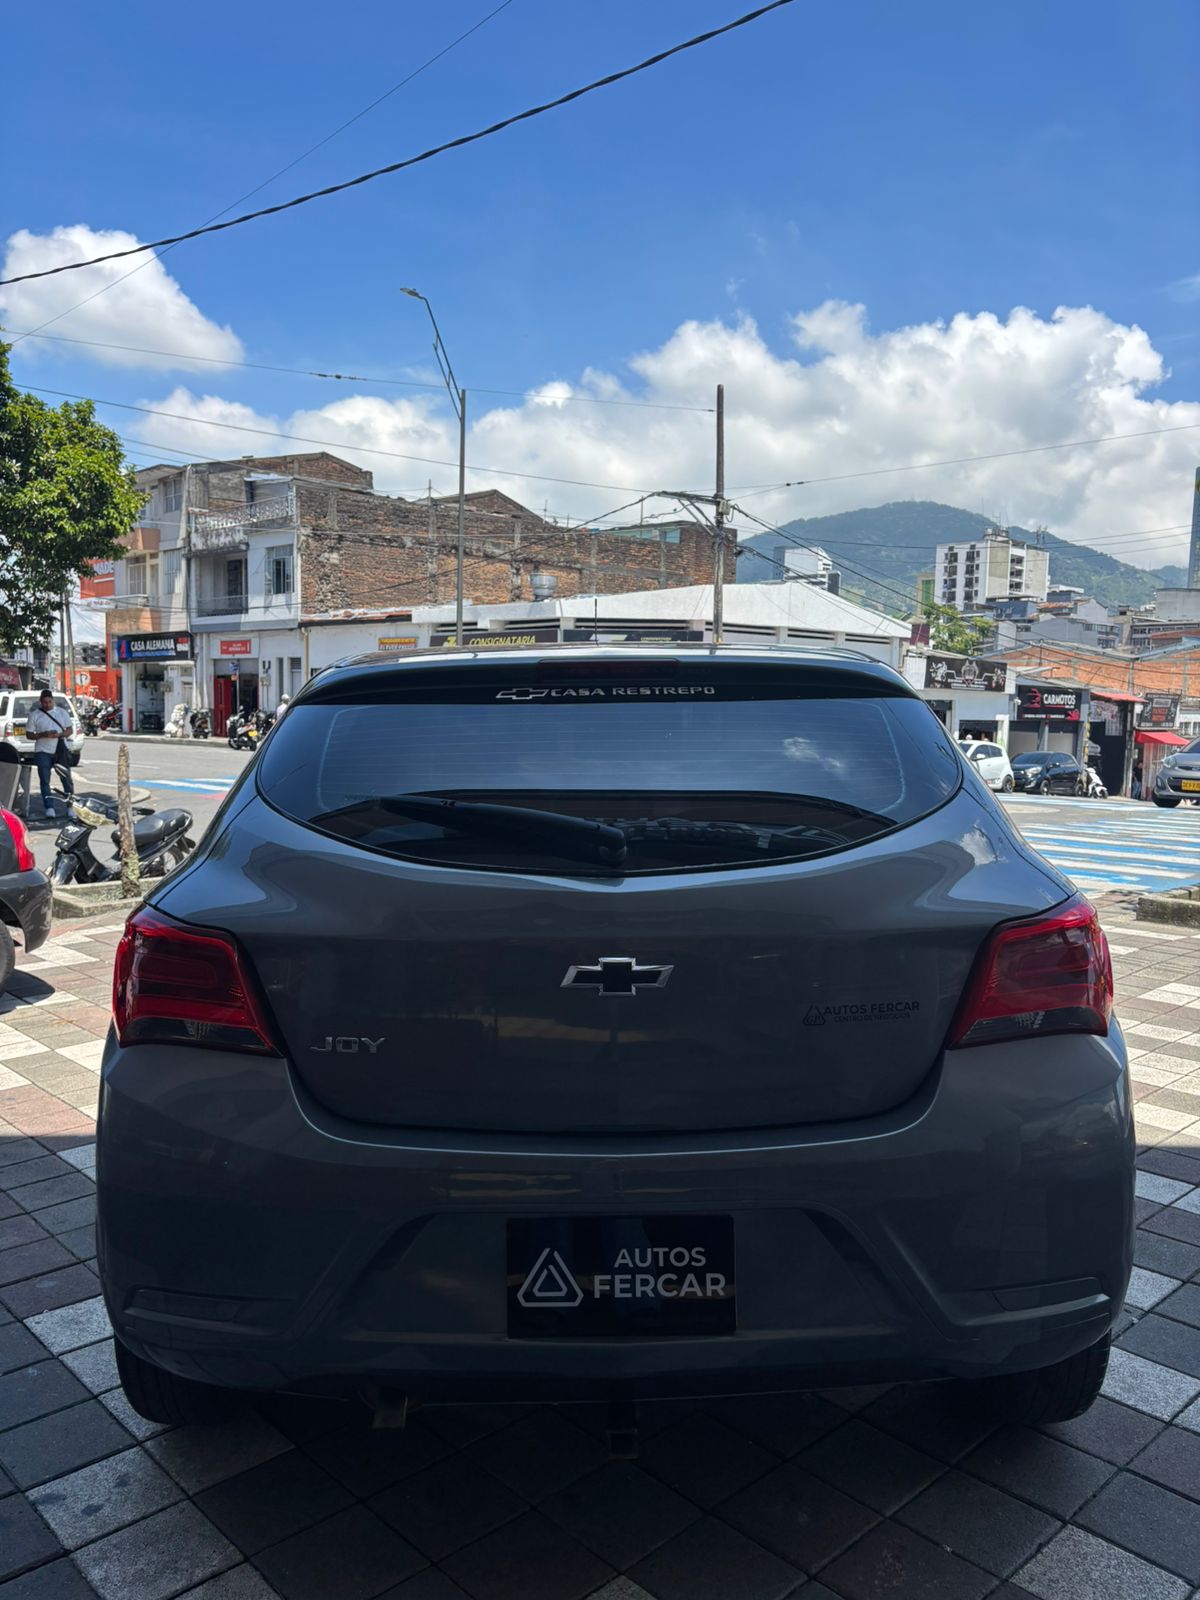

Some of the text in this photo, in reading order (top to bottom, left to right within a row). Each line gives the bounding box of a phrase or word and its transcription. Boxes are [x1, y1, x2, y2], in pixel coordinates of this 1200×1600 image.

[130, 641, 145, 651] CASA
[146, 638, 175, 650] ALEMANA
[469, 635, 536, 646] CONSIGNATARIA
[551, 686, 715, 697] CASA RESTREPO
[1043, 693, 1076, 705] CARMOTOS
[824, 1001, 920, 1015] AUTOS FERCAR
[310, 1036, 387, 1053] JOY
[613, 1246, 707, 1268] AUTOS
[593, 1272, 726, 1299] FERCAR
